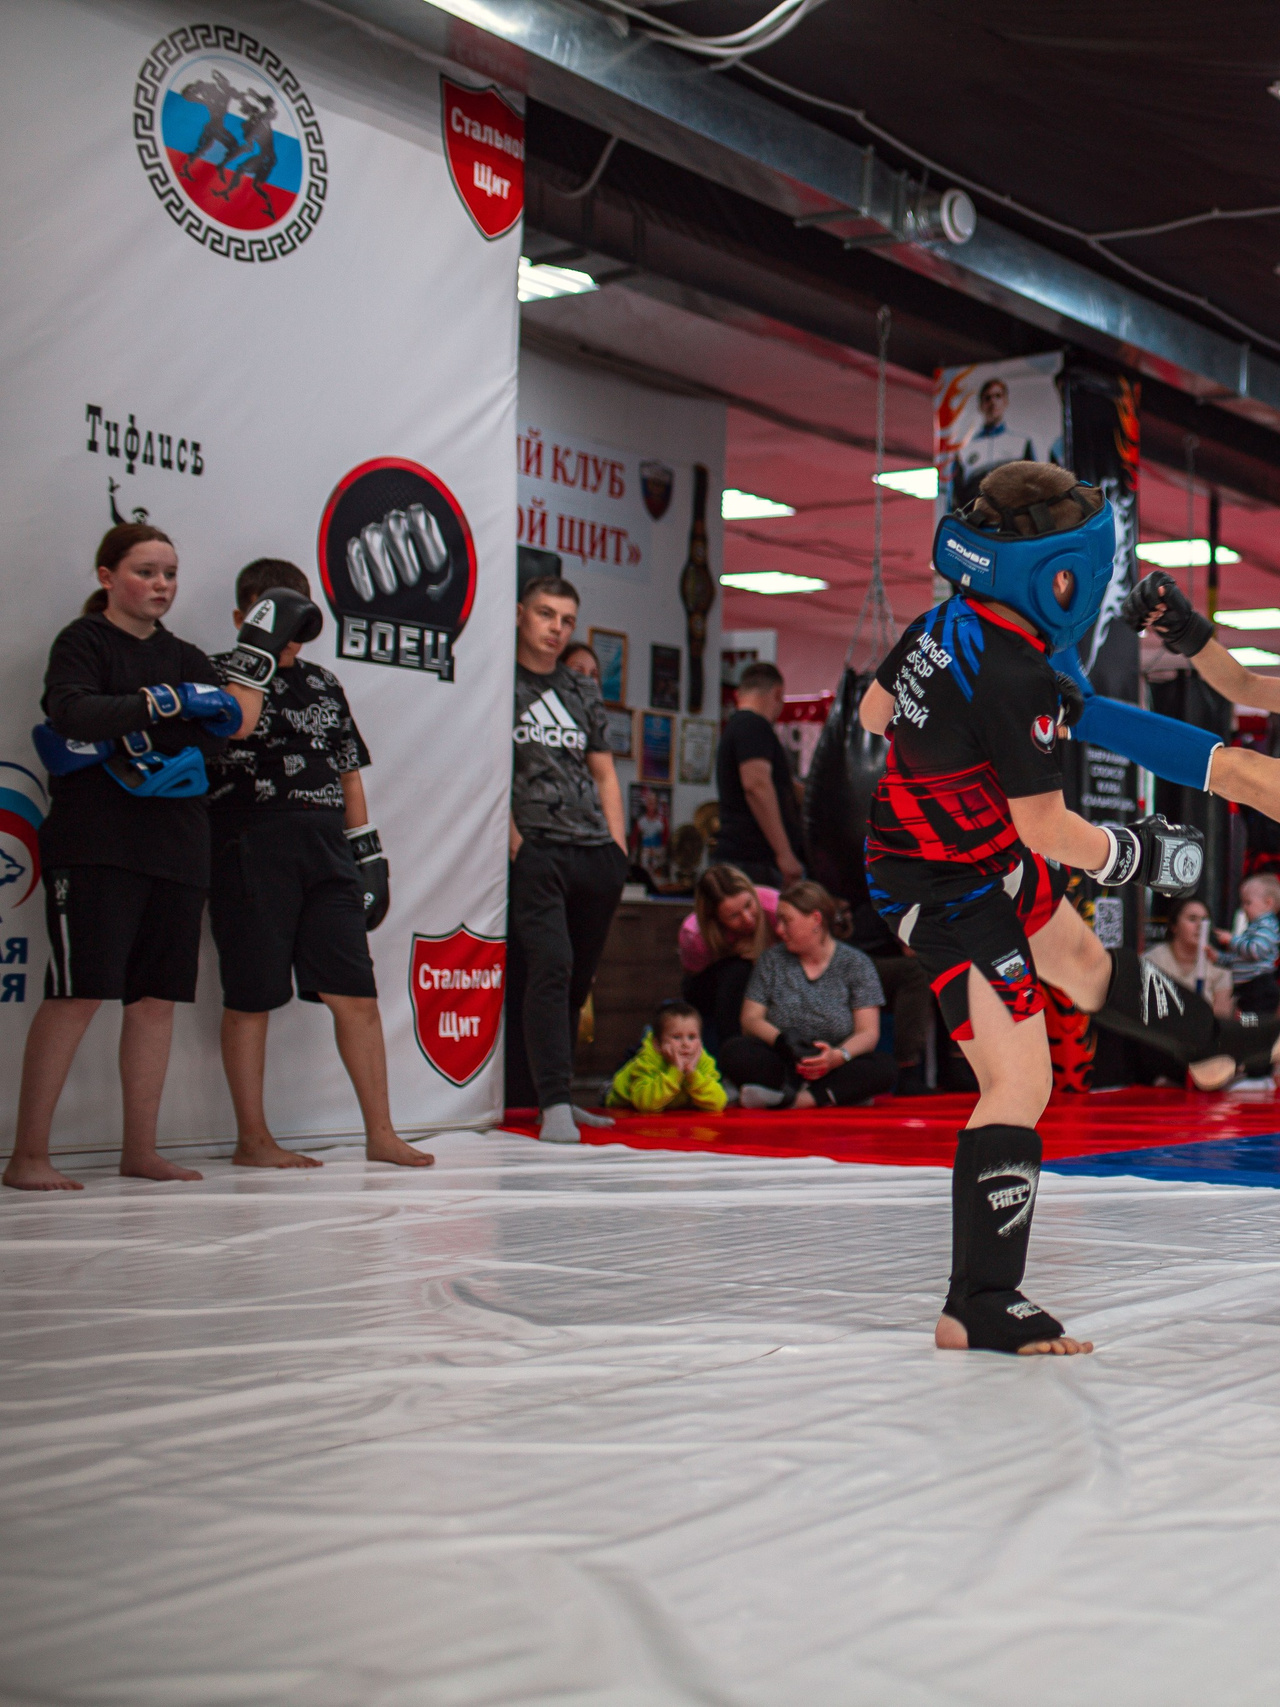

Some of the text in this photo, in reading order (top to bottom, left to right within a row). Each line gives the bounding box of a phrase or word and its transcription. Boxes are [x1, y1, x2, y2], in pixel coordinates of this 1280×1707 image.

[473, 160, 511, 199] Щит
[85, 403, 205, 475] Тифлисъ
[517, 426, 626, 499] Й КЛУБ
[556, 513, 642, 566] ЩИТ»
[342, 614, 450, 679] БОЕЦ
[512, 724, 588, 750] adidas
[0, 936, 28, 965] Я
[418, 962, 503, 990] Стальной
[438, 1010, 481, 1042] Щит
[987, 1183, 1030, 1202] GREEN
[992, 1192, 1028, 1212] HILL
